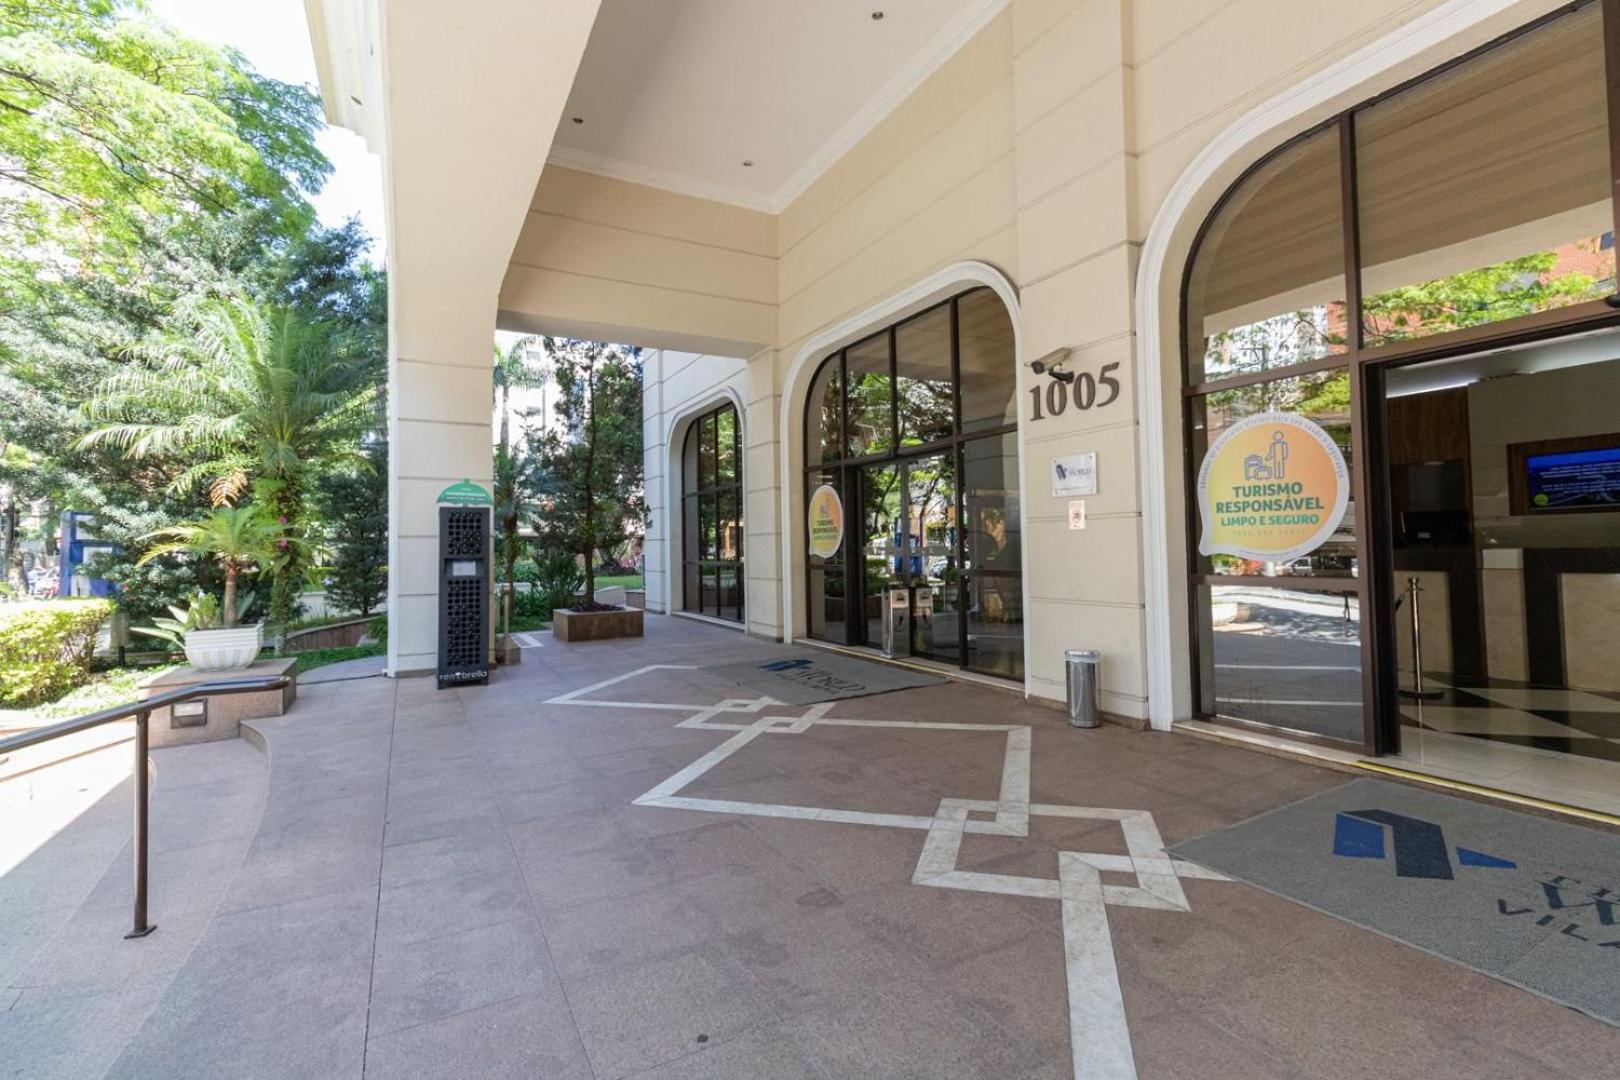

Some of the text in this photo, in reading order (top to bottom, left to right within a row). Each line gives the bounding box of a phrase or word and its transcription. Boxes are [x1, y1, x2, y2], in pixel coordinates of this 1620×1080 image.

[1029, 361, 1120, 422] 1005
[1232, 482, 1304, 498] TURISMO
[1215, 496, 1325, 514] RESPONSÁVEL
[1221, 513, 1320, 527] LIMPO E SEGURO
